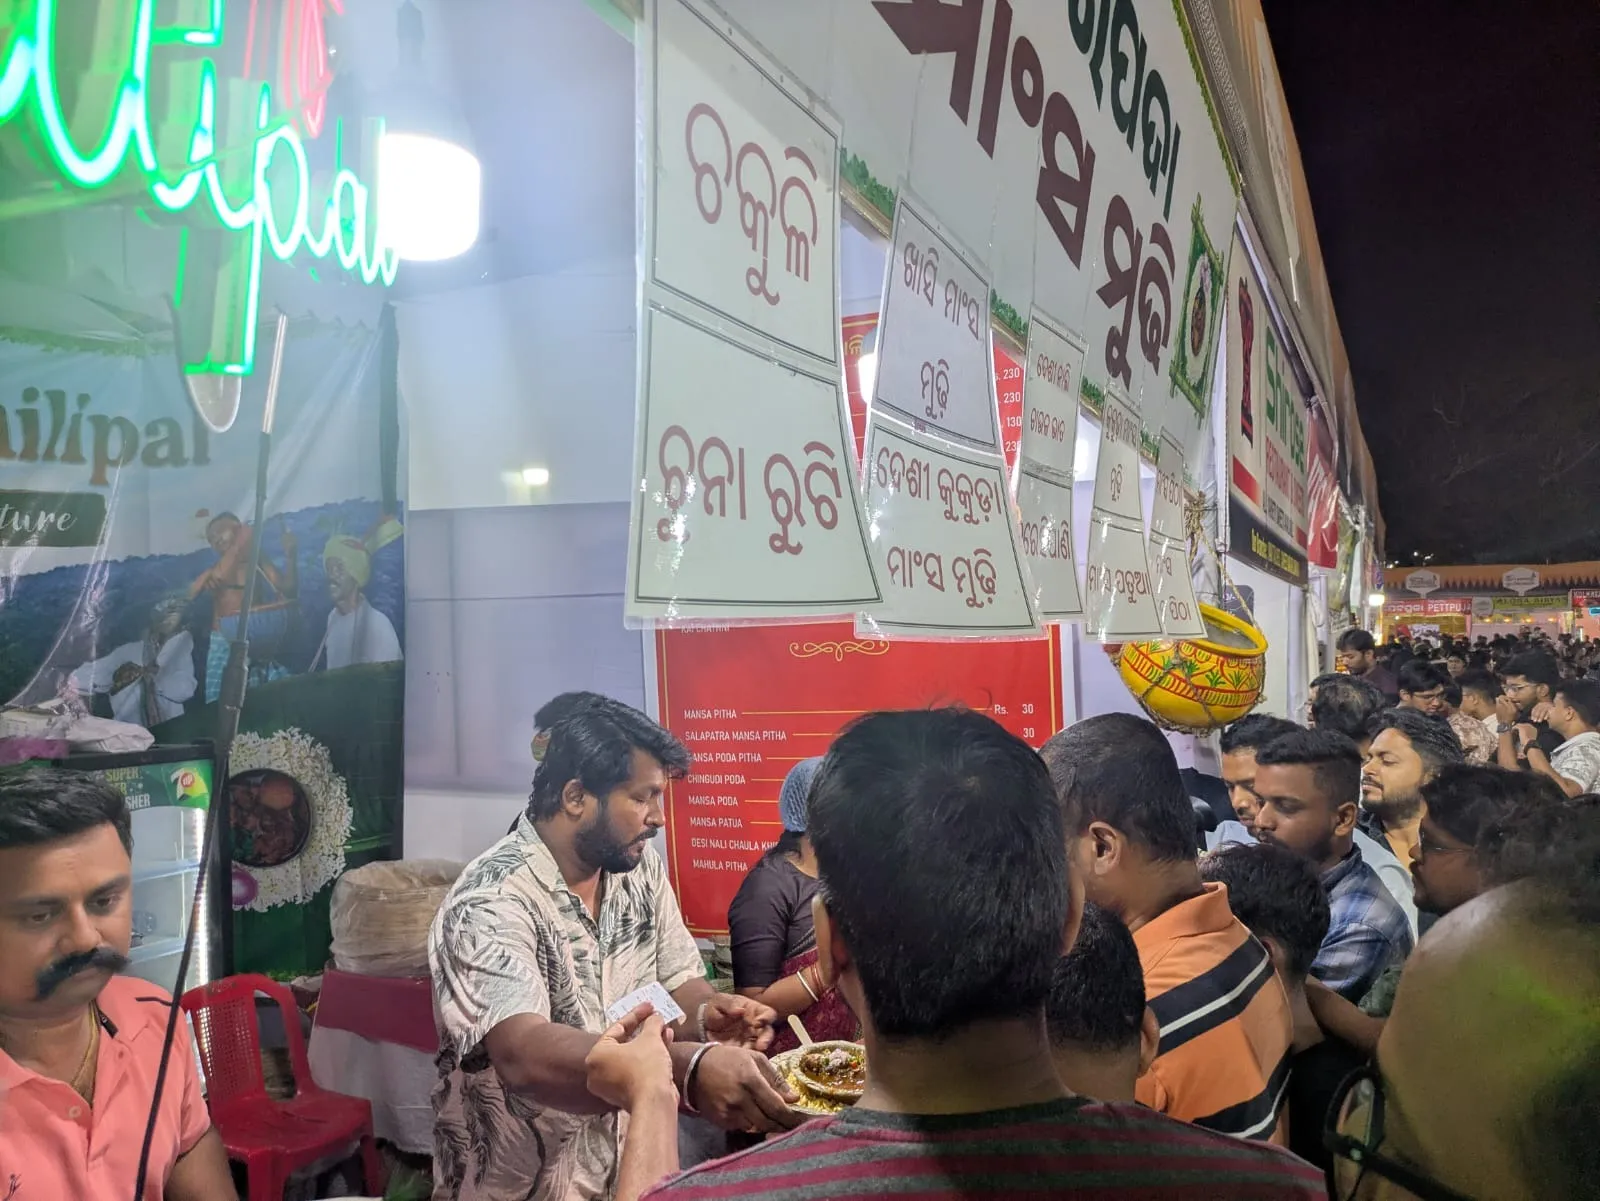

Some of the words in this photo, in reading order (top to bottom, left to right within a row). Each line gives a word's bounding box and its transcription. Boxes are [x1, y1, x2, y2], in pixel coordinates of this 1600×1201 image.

[686, 103, 817, 305] ଚକୁଳି
[886, 546, 946, 593] ମାଂସ
[684, 708, 712, 720] MANSA
[713, 707, 737, 719] PITHA
[994, 704, 1009, 715] Rs.
[1021, 704, 1034, 715] 30
[684, 730, 730, 742] SALAPATRA
[732, 730, 761, 741] MANSA
[762, 730, 787, 741] PITHA
[1023, 728, 1035, 739] 30
[715, 751, 737, 763] PODA
[738, 751, 762, 763] PITHA
[105, 767, 139, 781] SUPER
[687, 774, 723, 784] CHINGUDI
[724, 775, 746, 785] PODA
[688, 795, 715, 806] MANSA
[717, 796, 738, 806] PODA
[690, 817, 717, 827] MANSA
[718, 817, 743, 828] PATUA
[709, 838, 727, 849] NALI
[728, 840, 759, 851] CHAULA
[692, 859, 723, 870] MAHULA
[725, 860, 748, 871] PITHA
